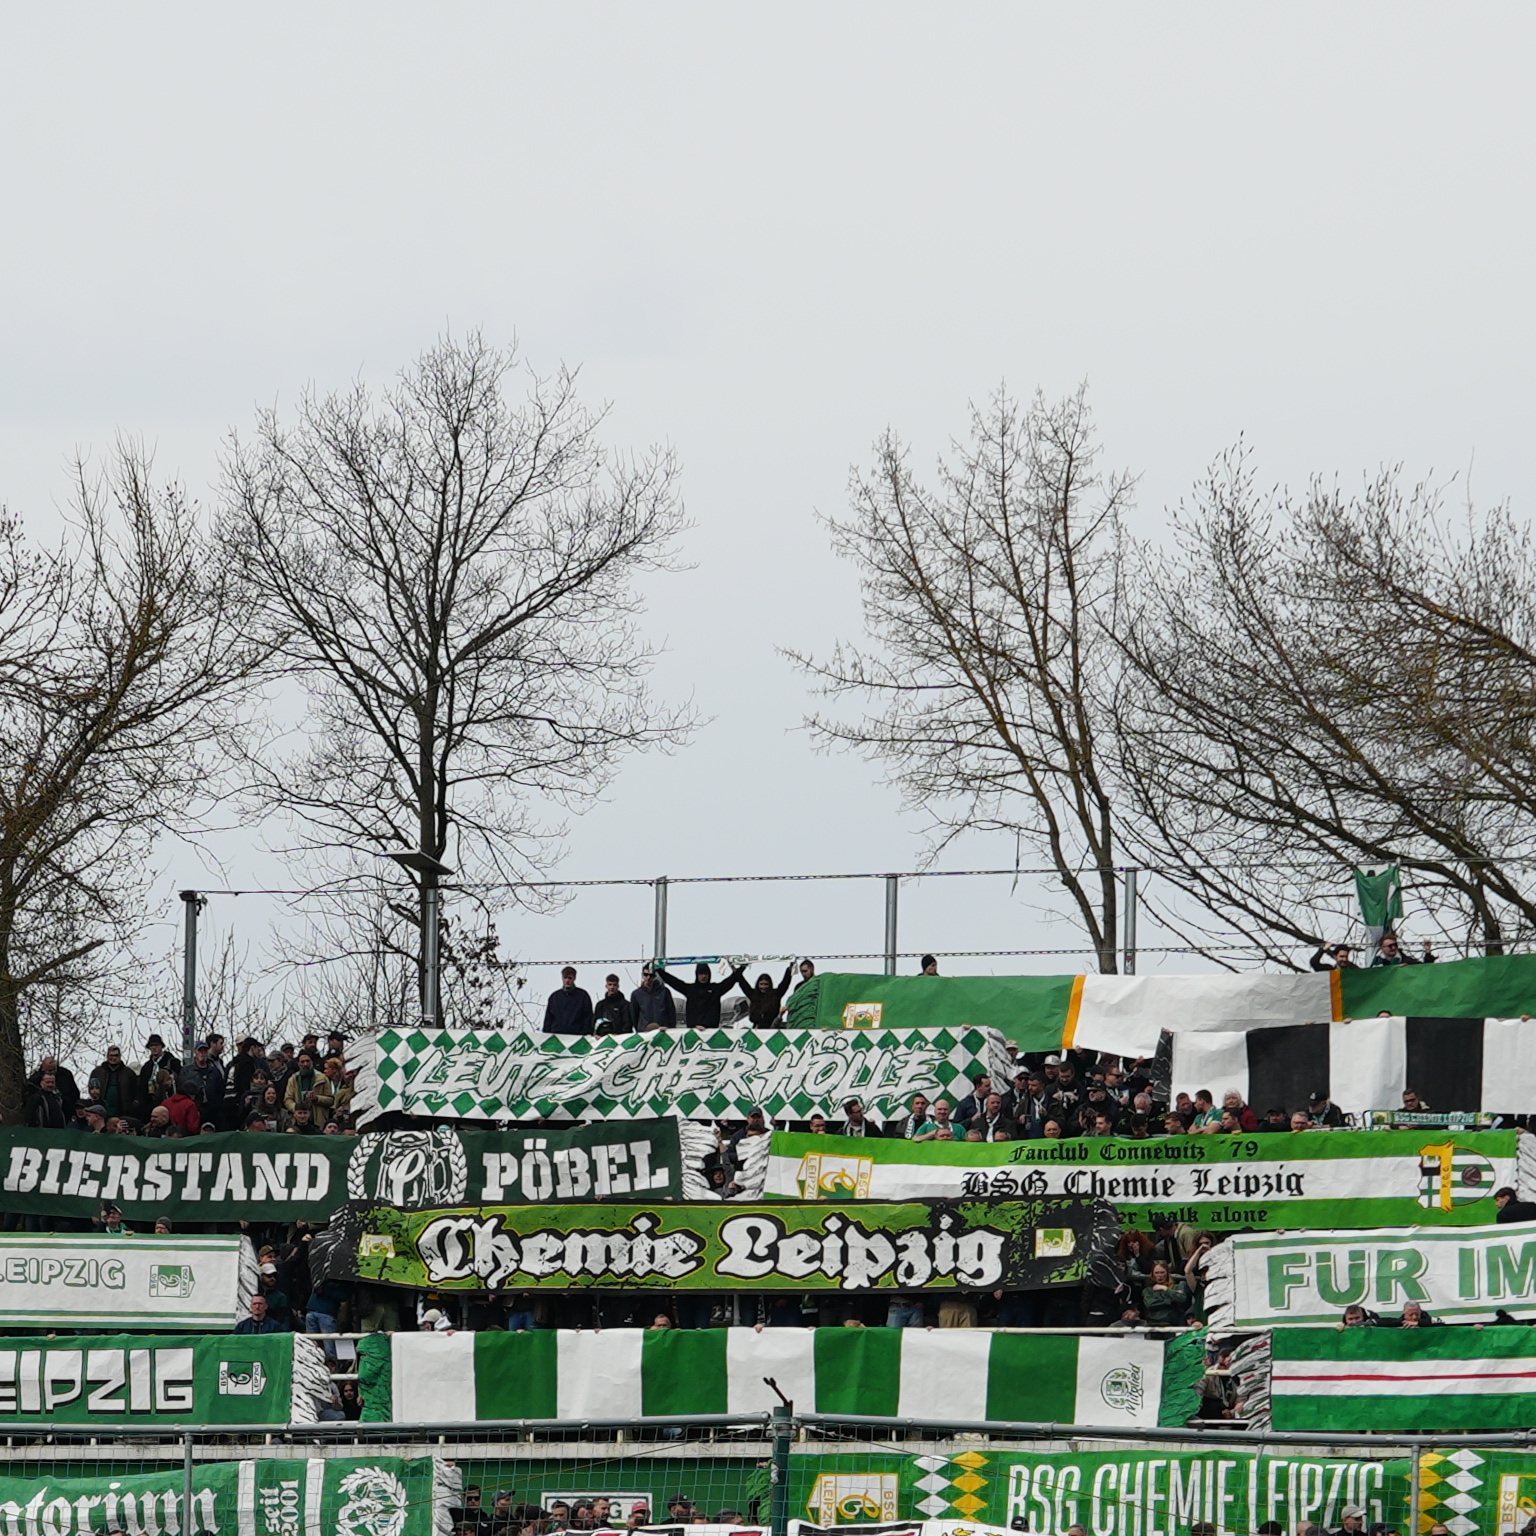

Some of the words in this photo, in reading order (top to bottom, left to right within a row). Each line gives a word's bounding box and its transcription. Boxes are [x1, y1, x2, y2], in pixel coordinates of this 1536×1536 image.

[406, 1041, 763, 1110] LEUTZSCHER
[754, 1036, 950, 1115] HÖLLE
[3, 1146, 330, 1201] BIERSTAND
[482, 1136, 670, 1201] PÖBEL
[961, 1170, 1049, 1197] BSG
[1063, 1168, 1175, 1200] Chemie
[1189, 1166, 1305, 1198] Leipzig
[1009, 1143, 1089, 1162] Fanclub
[1099, 1141, 1206, 1162] Connewitz
[1211, 1209, 1268, 1223] alone
[416, 1211, 704, 1288] Chemie
[718, 1212, 1005, 1288] Leipzig
[1007, 1464, 1080, 1528] BSG
[1267, 1459, 1384, 1536] LEIPZIG
